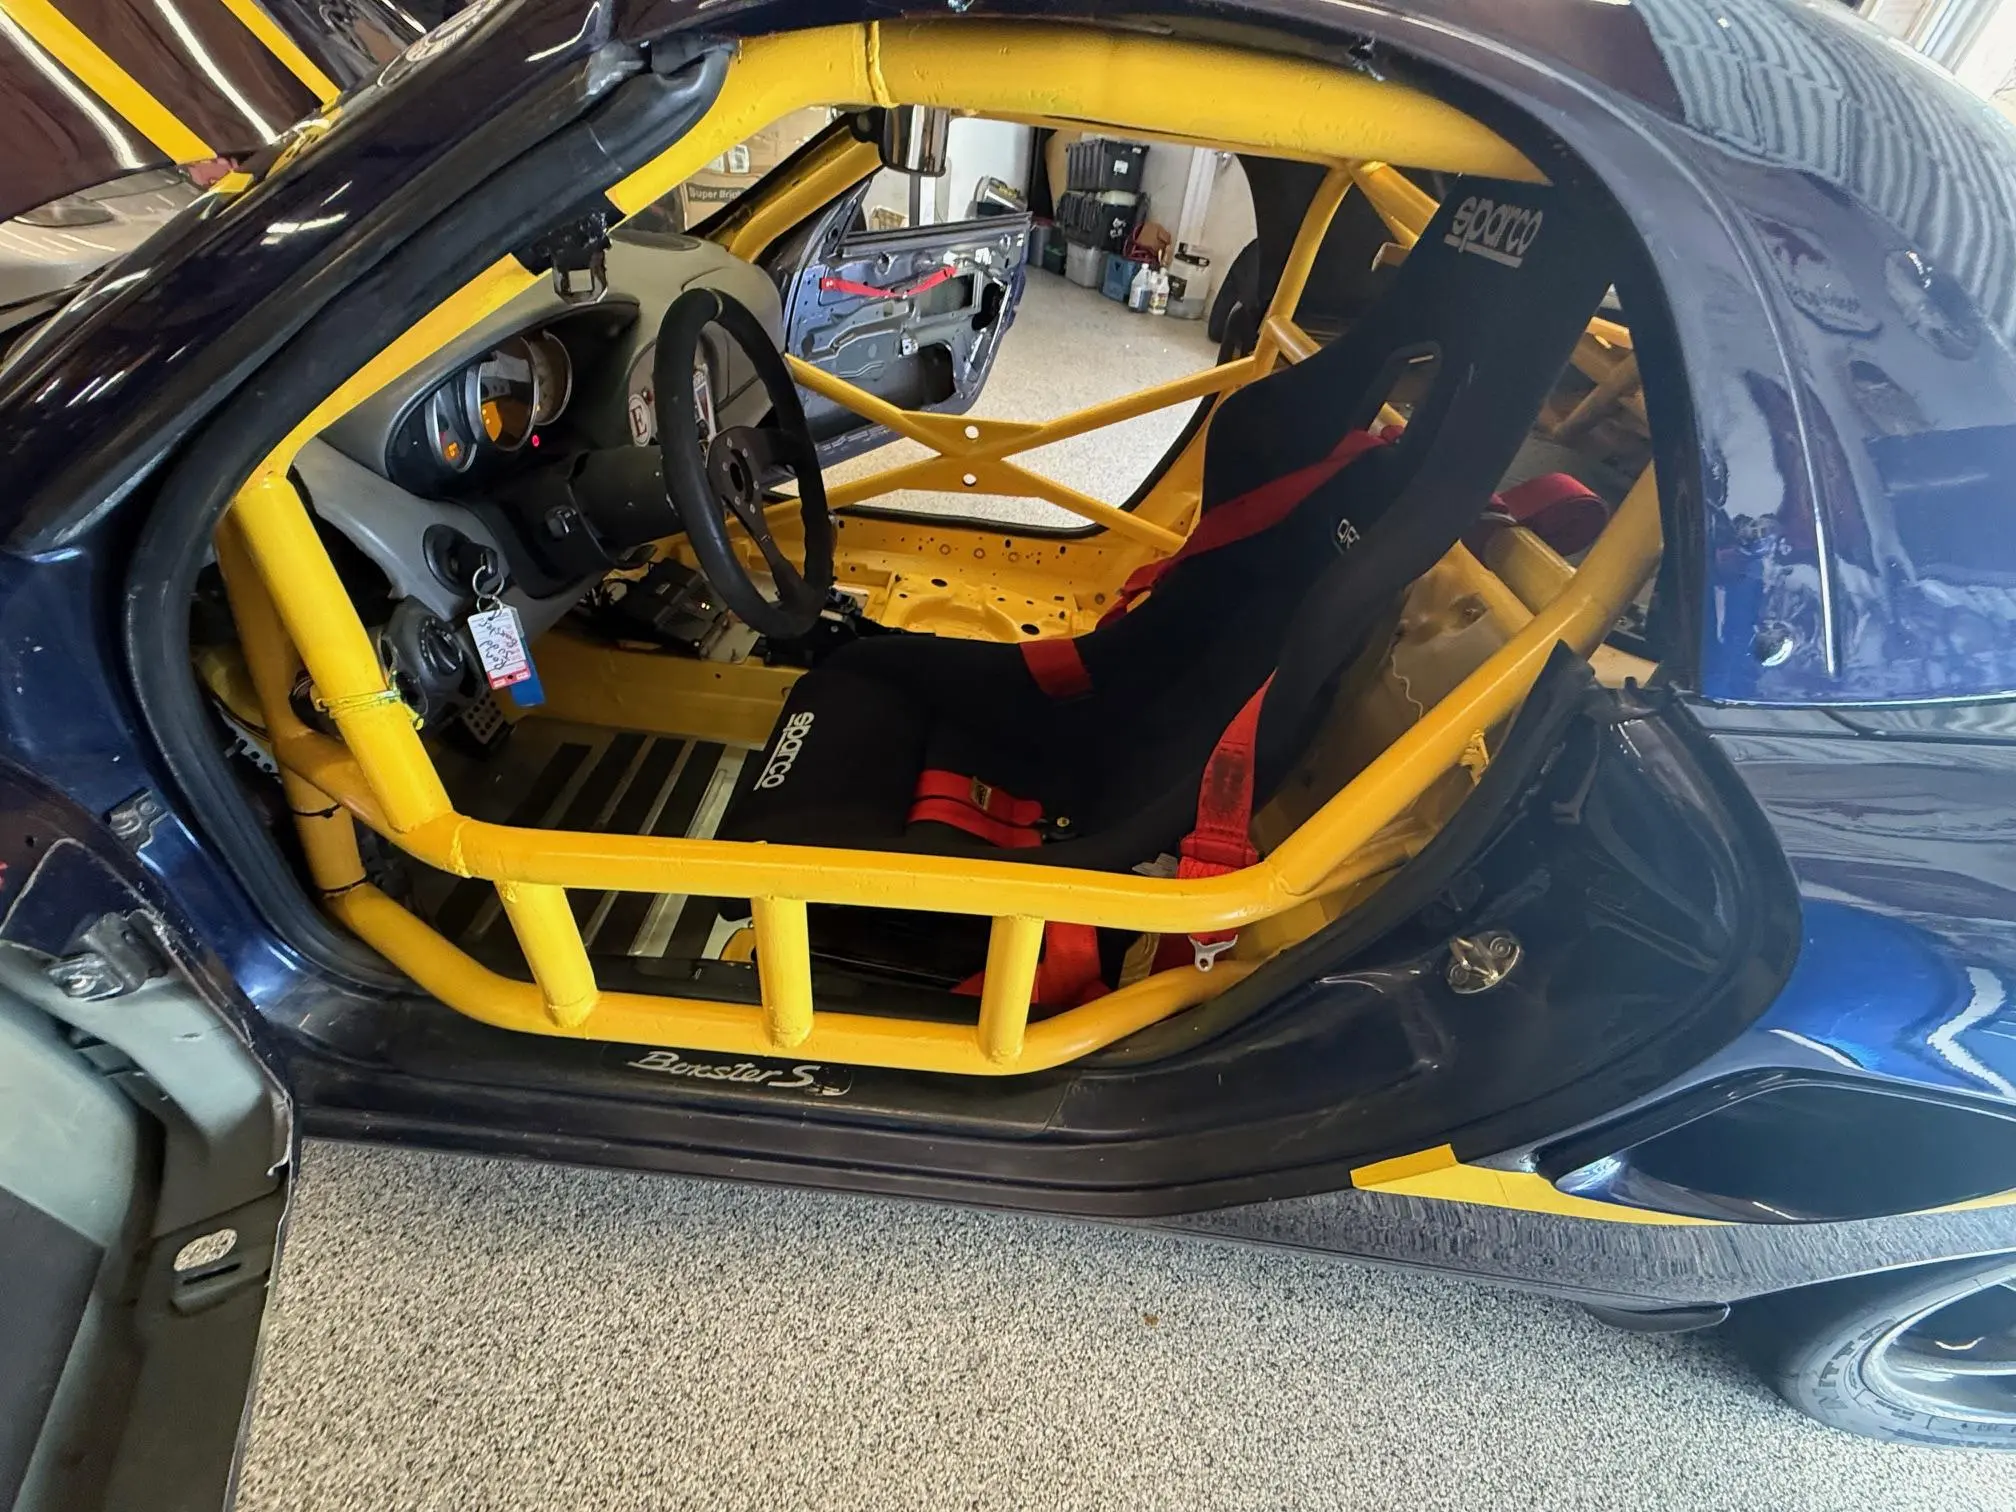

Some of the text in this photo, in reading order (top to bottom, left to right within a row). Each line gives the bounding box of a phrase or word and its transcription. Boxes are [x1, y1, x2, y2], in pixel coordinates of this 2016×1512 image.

[1444, 196, 1544, 269] sparco
[753, 711, 815, 792] sparco
[626, 1050, 821, 1088] Boxster S
